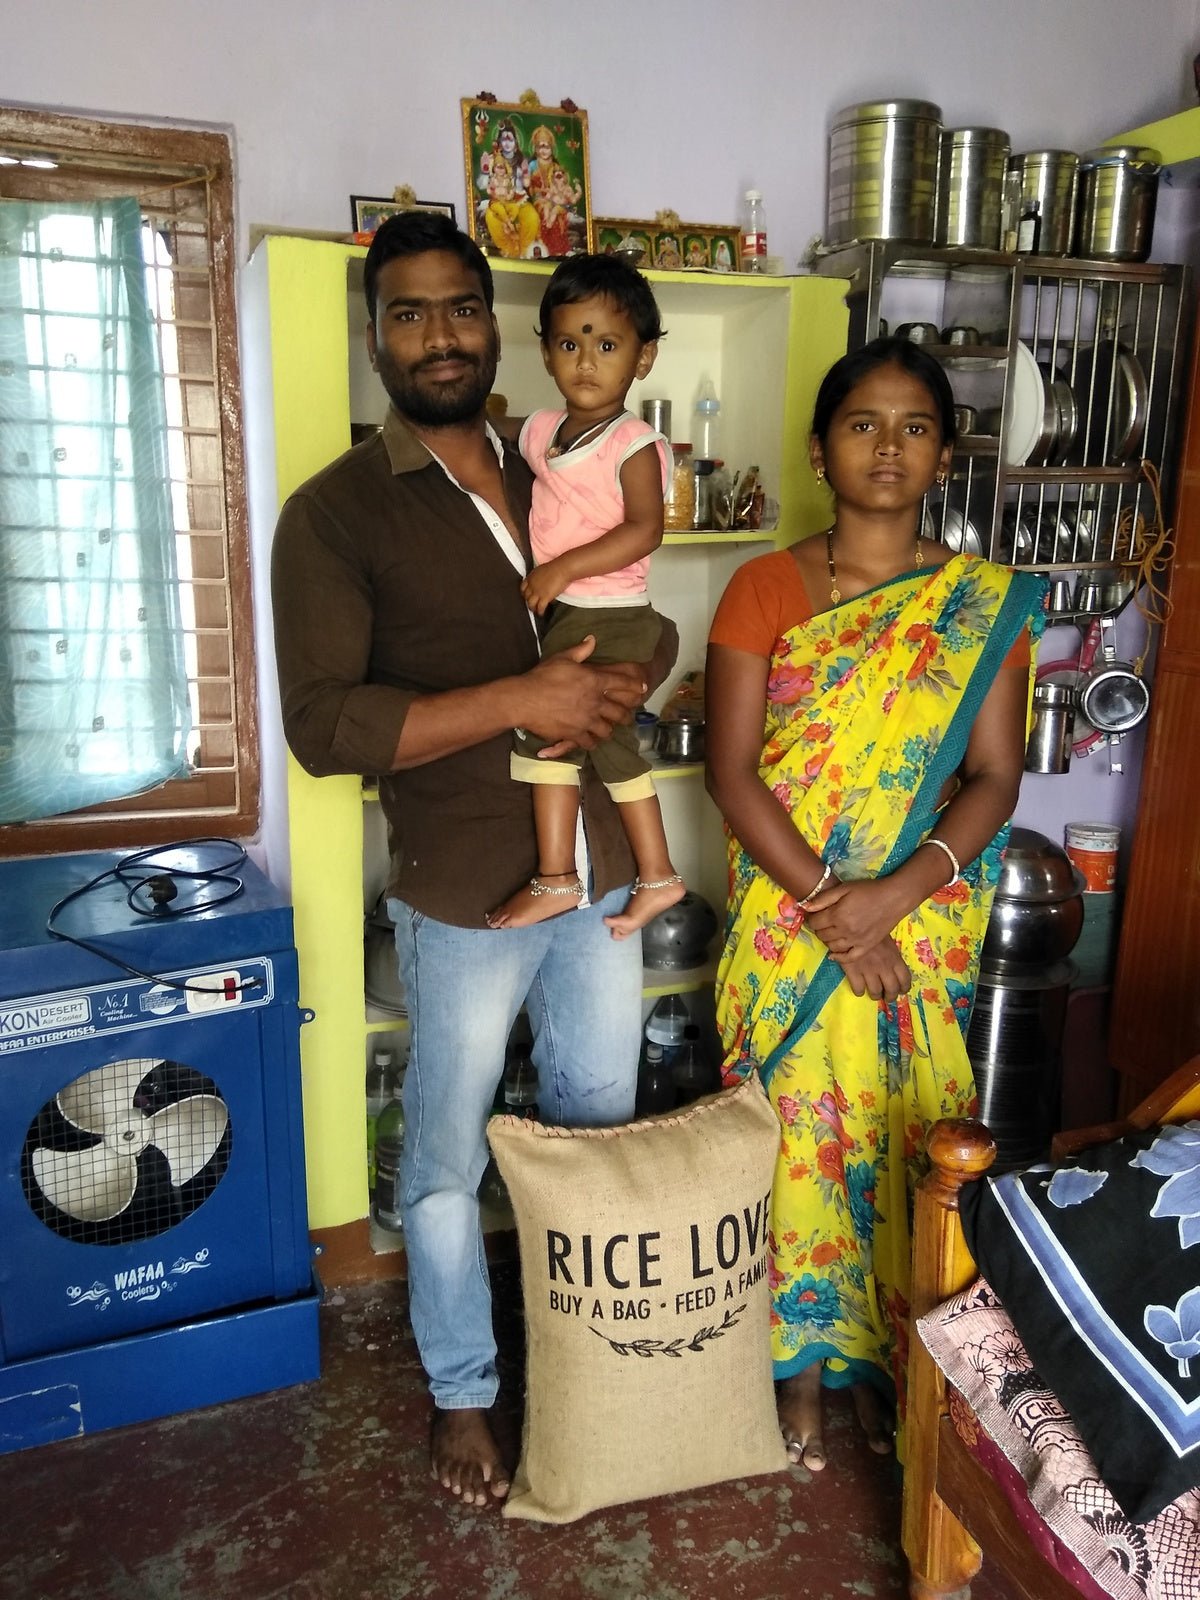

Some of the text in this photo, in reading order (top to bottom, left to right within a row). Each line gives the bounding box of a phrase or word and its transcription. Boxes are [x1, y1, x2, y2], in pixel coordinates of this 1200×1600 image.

[0, 1002, 84, 1033] KON DESERT
[56, 1013, 83, 1023] Cooler
[27, 1025, 97, 1046] ENTERPRISES
[547, 1188, 771, 1289] RICE LOVE
[114, 1261, 164, 1290] WAFAA
[122, 1284, 155, 1301] Coolers
[550, 1290, 582, 1316] BUY
[592, 1299, 604, 1320] A
[613, 1299, 651, 1320] BAG
[676, 1286, 716, 1315] FEED
[724, 1279, 733, 1301] A
